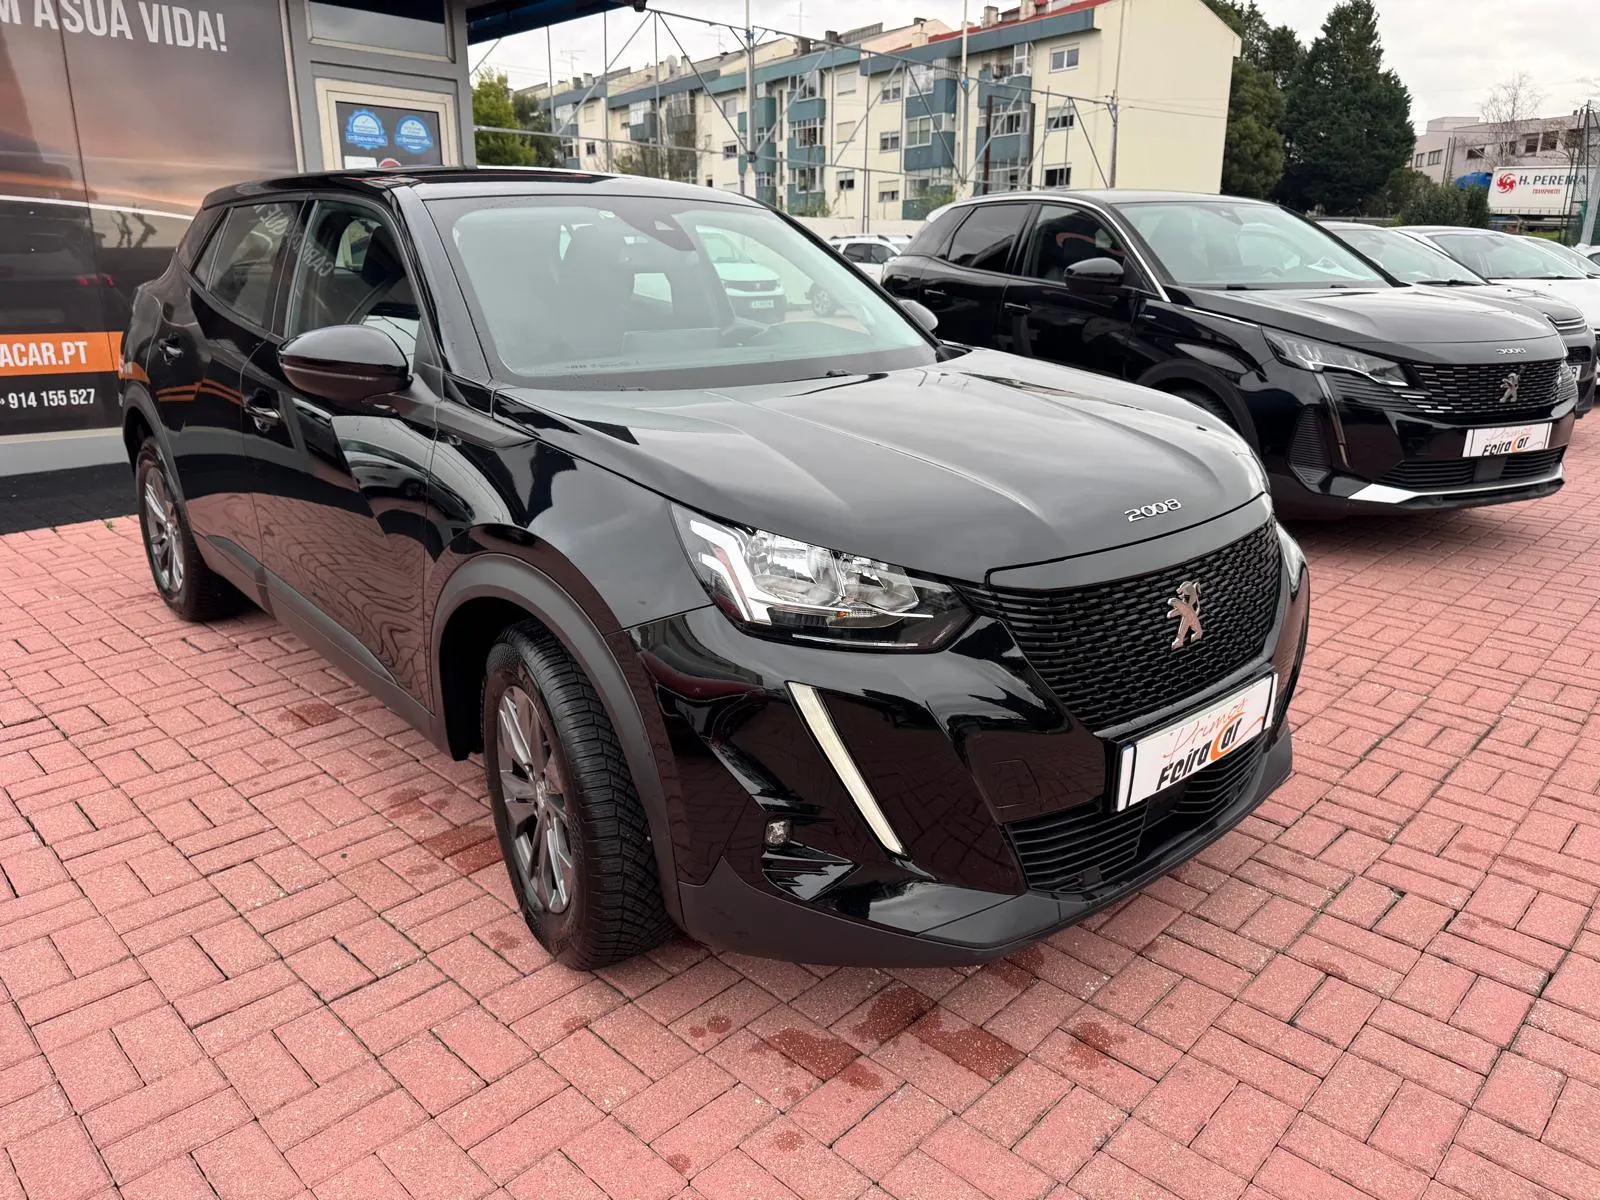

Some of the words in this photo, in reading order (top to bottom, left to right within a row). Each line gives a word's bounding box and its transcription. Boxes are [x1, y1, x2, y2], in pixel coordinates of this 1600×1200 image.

[138, 1, 228, 52] VIDA!
[1518, 175, 1530, 185] H.
[1532, 174, 1586, 186] PEREIRA
[8, 391, 37, 409] 914
[40, 389, 68, 407] 155
[69, 388, 96, 405] 527
[1124, 498, 1182, 522] 2008
